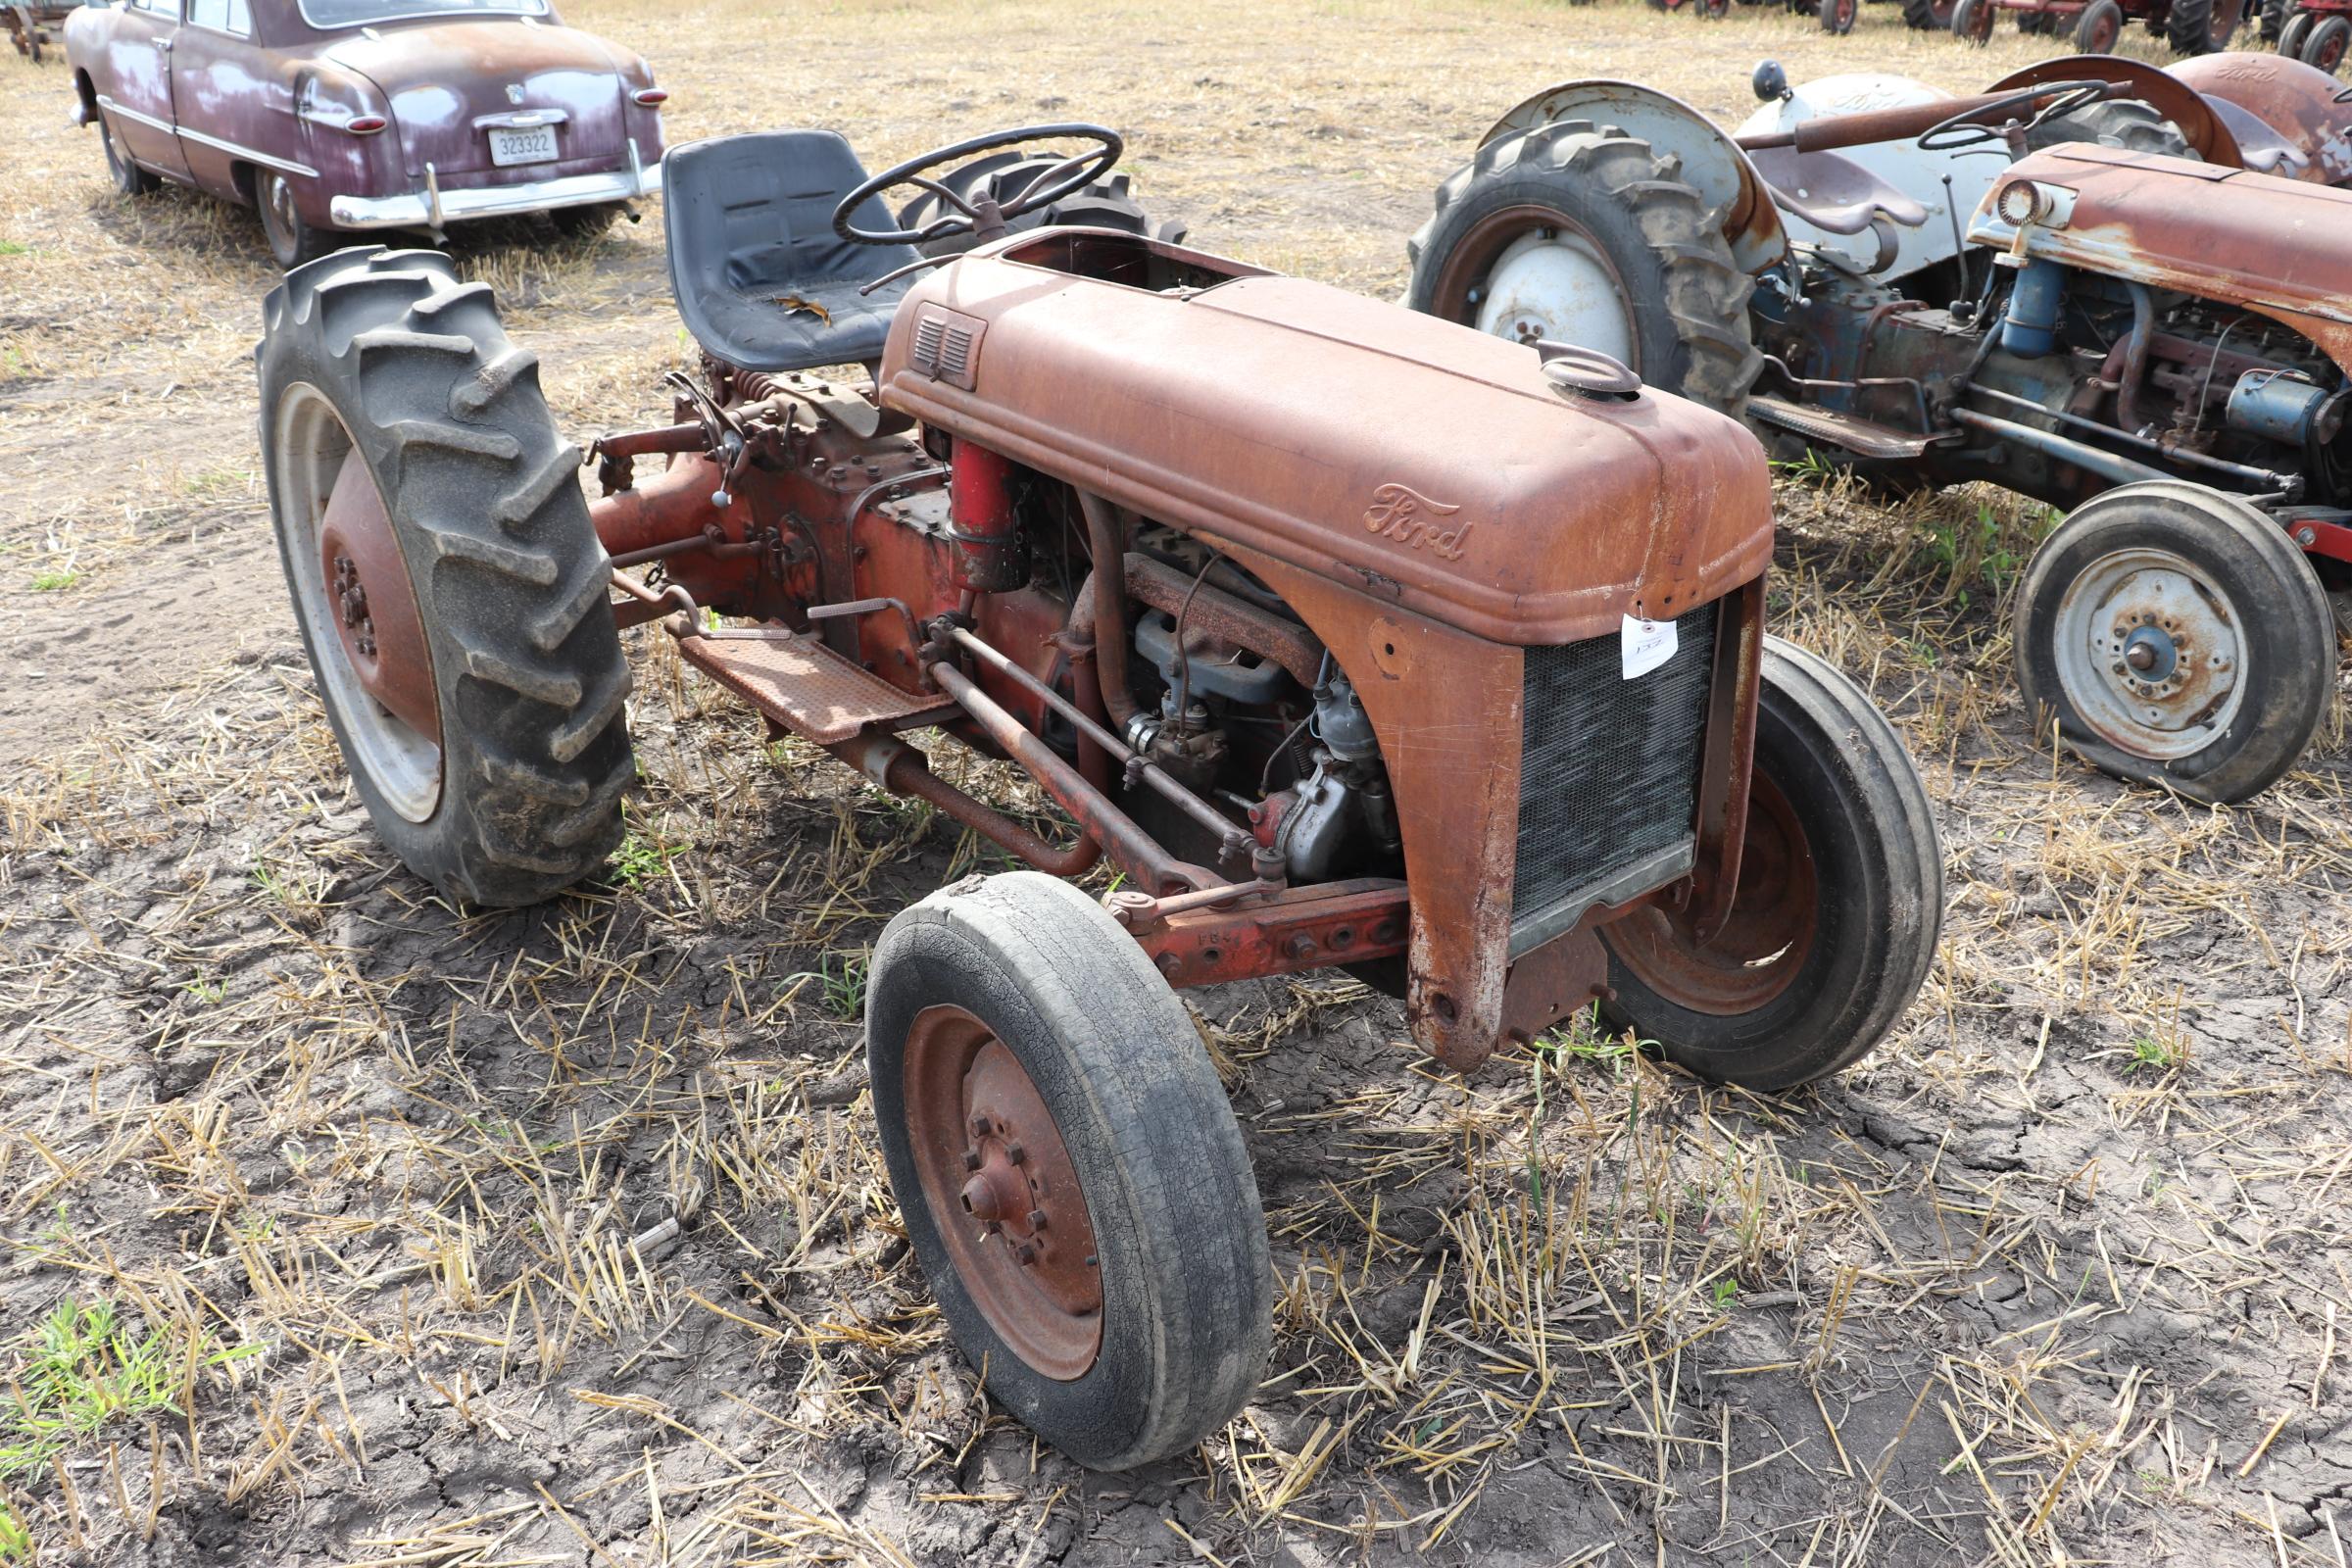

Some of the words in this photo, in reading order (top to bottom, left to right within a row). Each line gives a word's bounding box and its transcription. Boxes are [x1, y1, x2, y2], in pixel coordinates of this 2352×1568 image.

[2216, 62, 2278, 83] Ford
[500, 133, 550, 156] 323322
[1363, 482, 1473, 562] Ford
